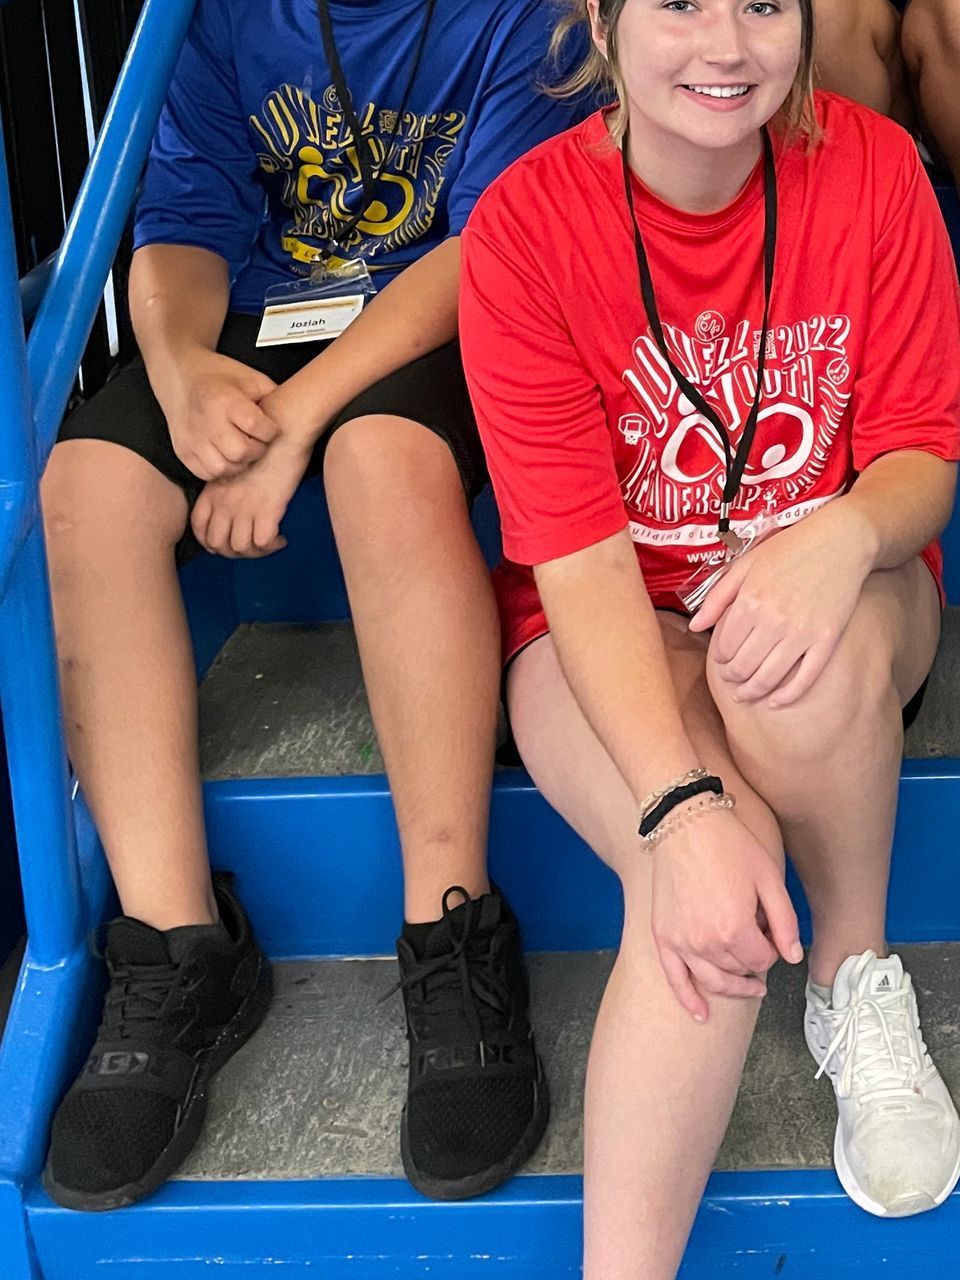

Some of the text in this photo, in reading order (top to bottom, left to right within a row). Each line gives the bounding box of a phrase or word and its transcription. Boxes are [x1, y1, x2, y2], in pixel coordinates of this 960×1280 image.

[290, 318, 326, 329] Joziah
[776, 314, 852, 363] 2022
[705, 354, 815, 433] YOUTH
